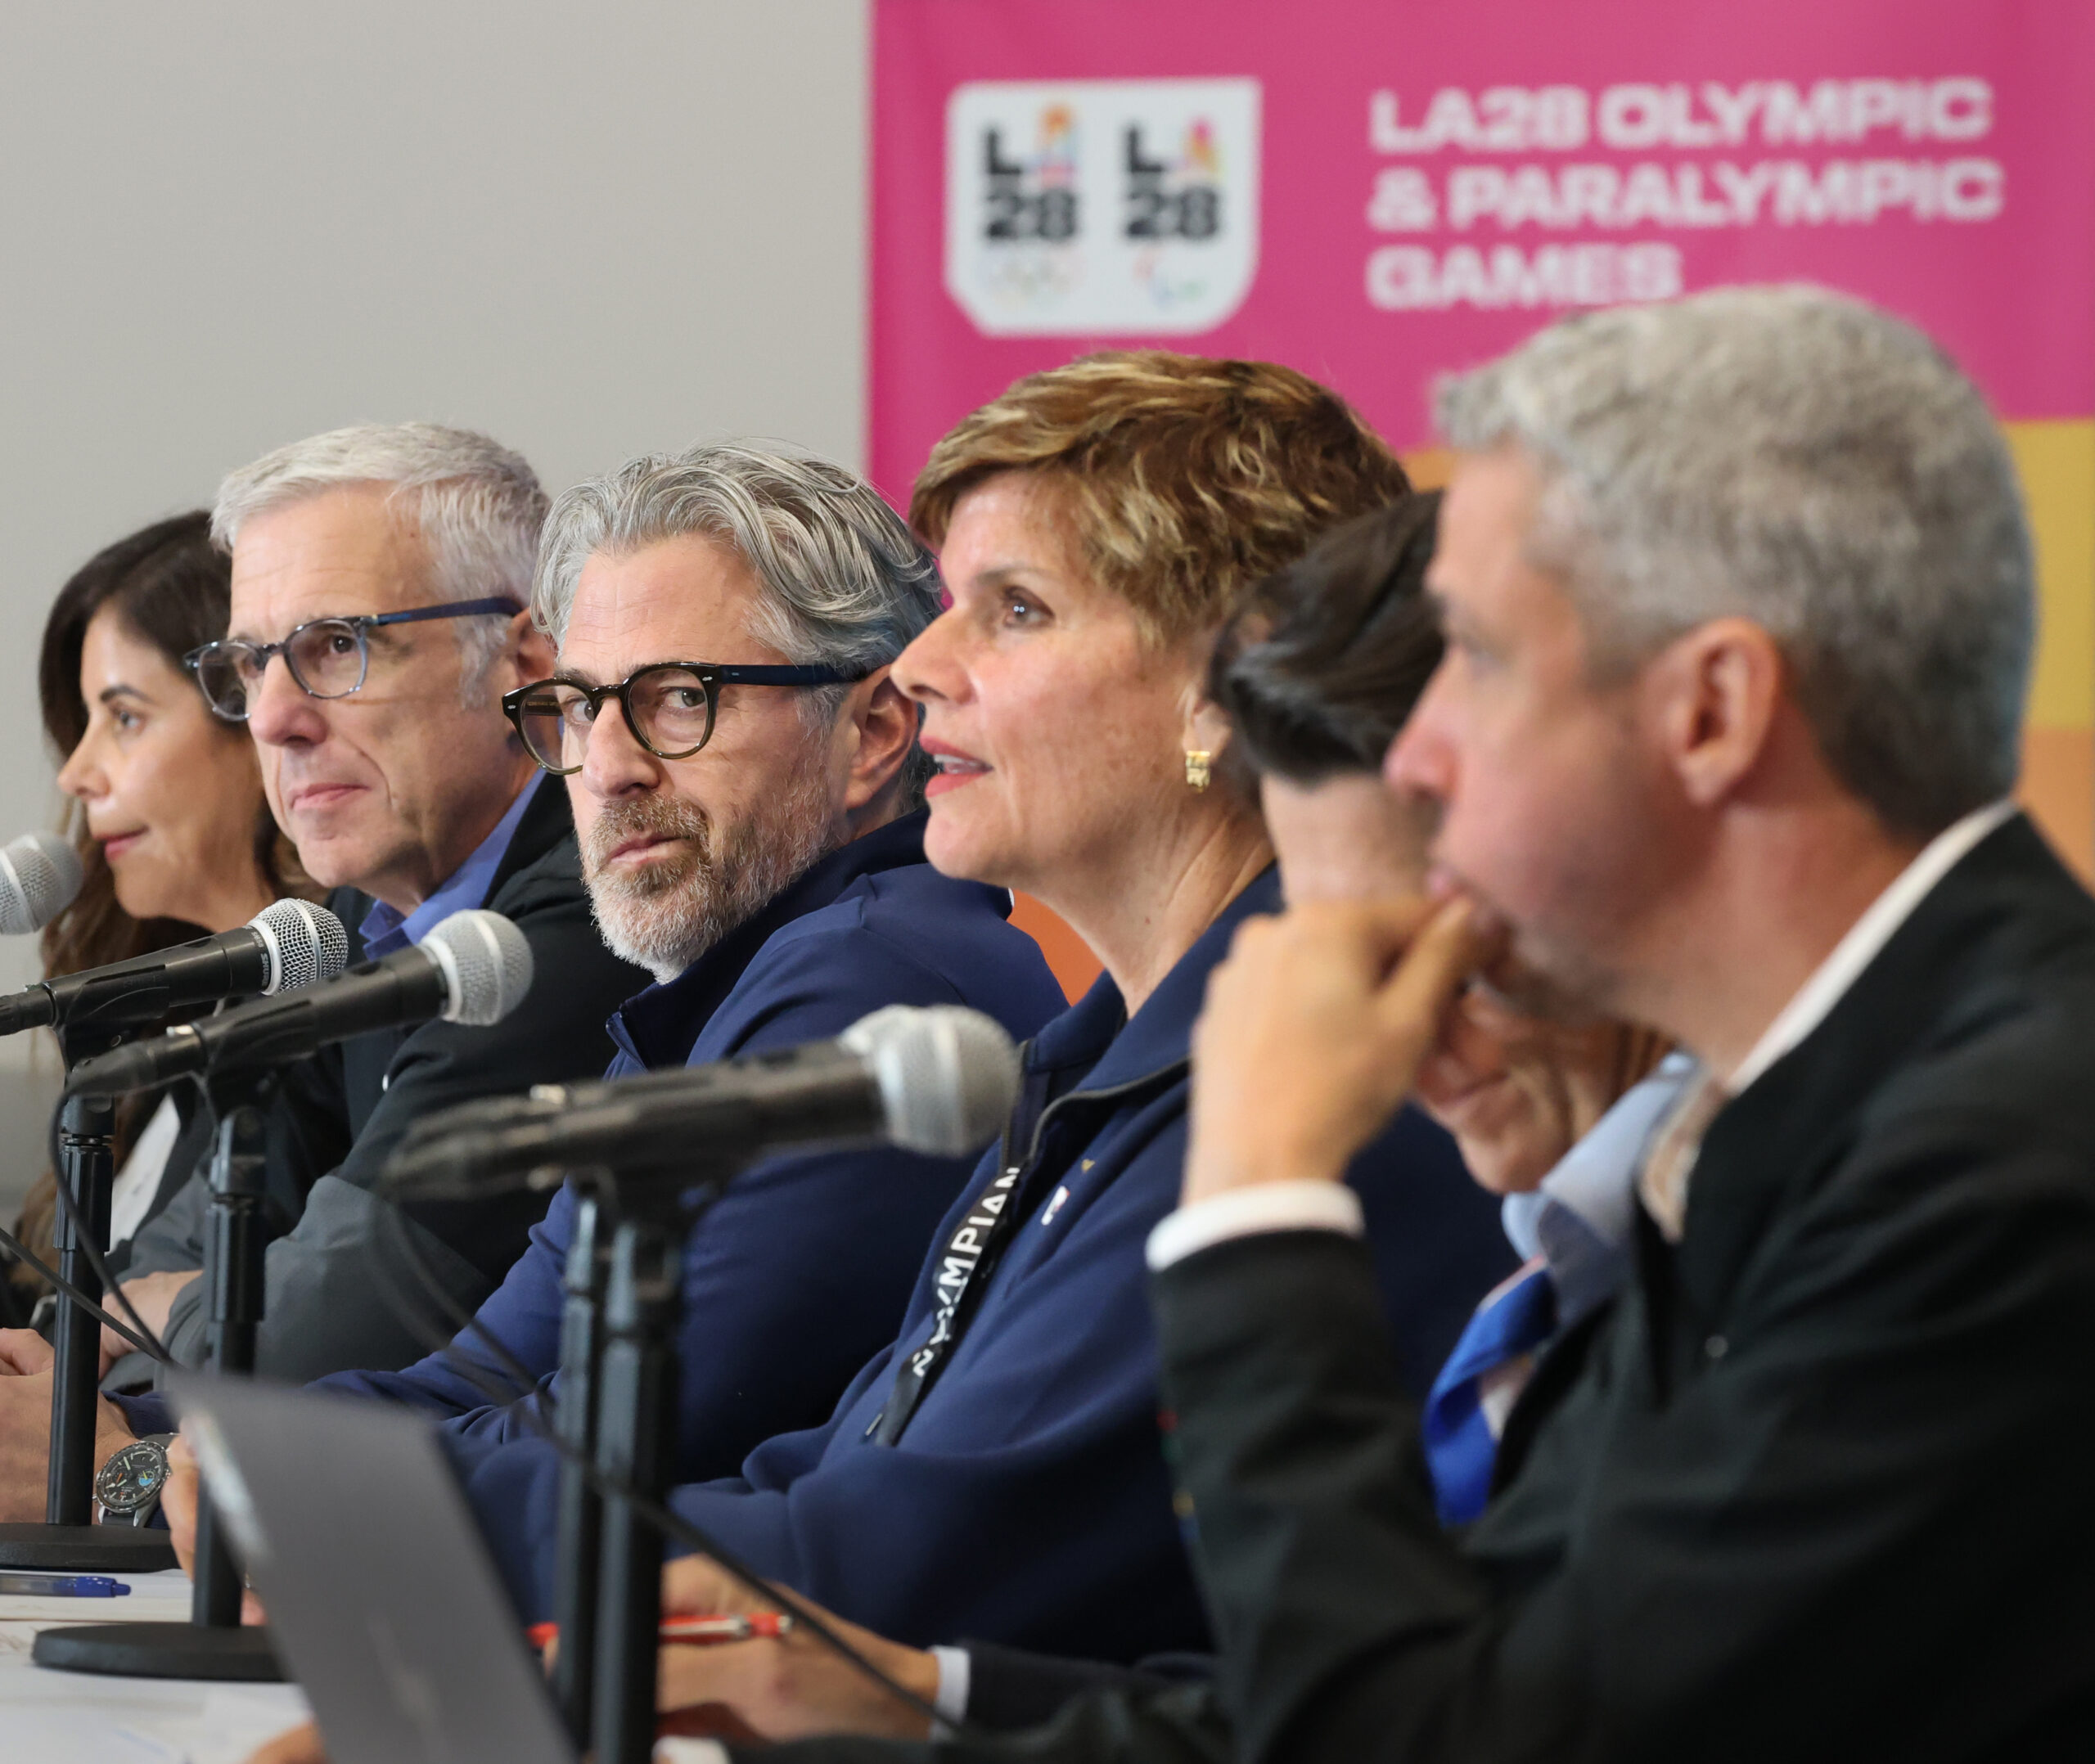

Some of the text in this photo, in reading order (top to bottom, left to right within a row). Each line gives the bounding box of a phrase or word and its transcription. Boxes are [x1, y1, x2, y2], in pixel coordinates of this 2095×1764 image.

[1370, 79, 1989, 152] LA28 OLYMPIC
[984, 185, 1077, 242] 28
[1124, 185, 1219, 241] 28
[1368, 160, 2001, 231] & PARALYMPIC
[1367, 242, 1681, 309] GAMES
[930, 1167, 1021, 1345] MPIAN
